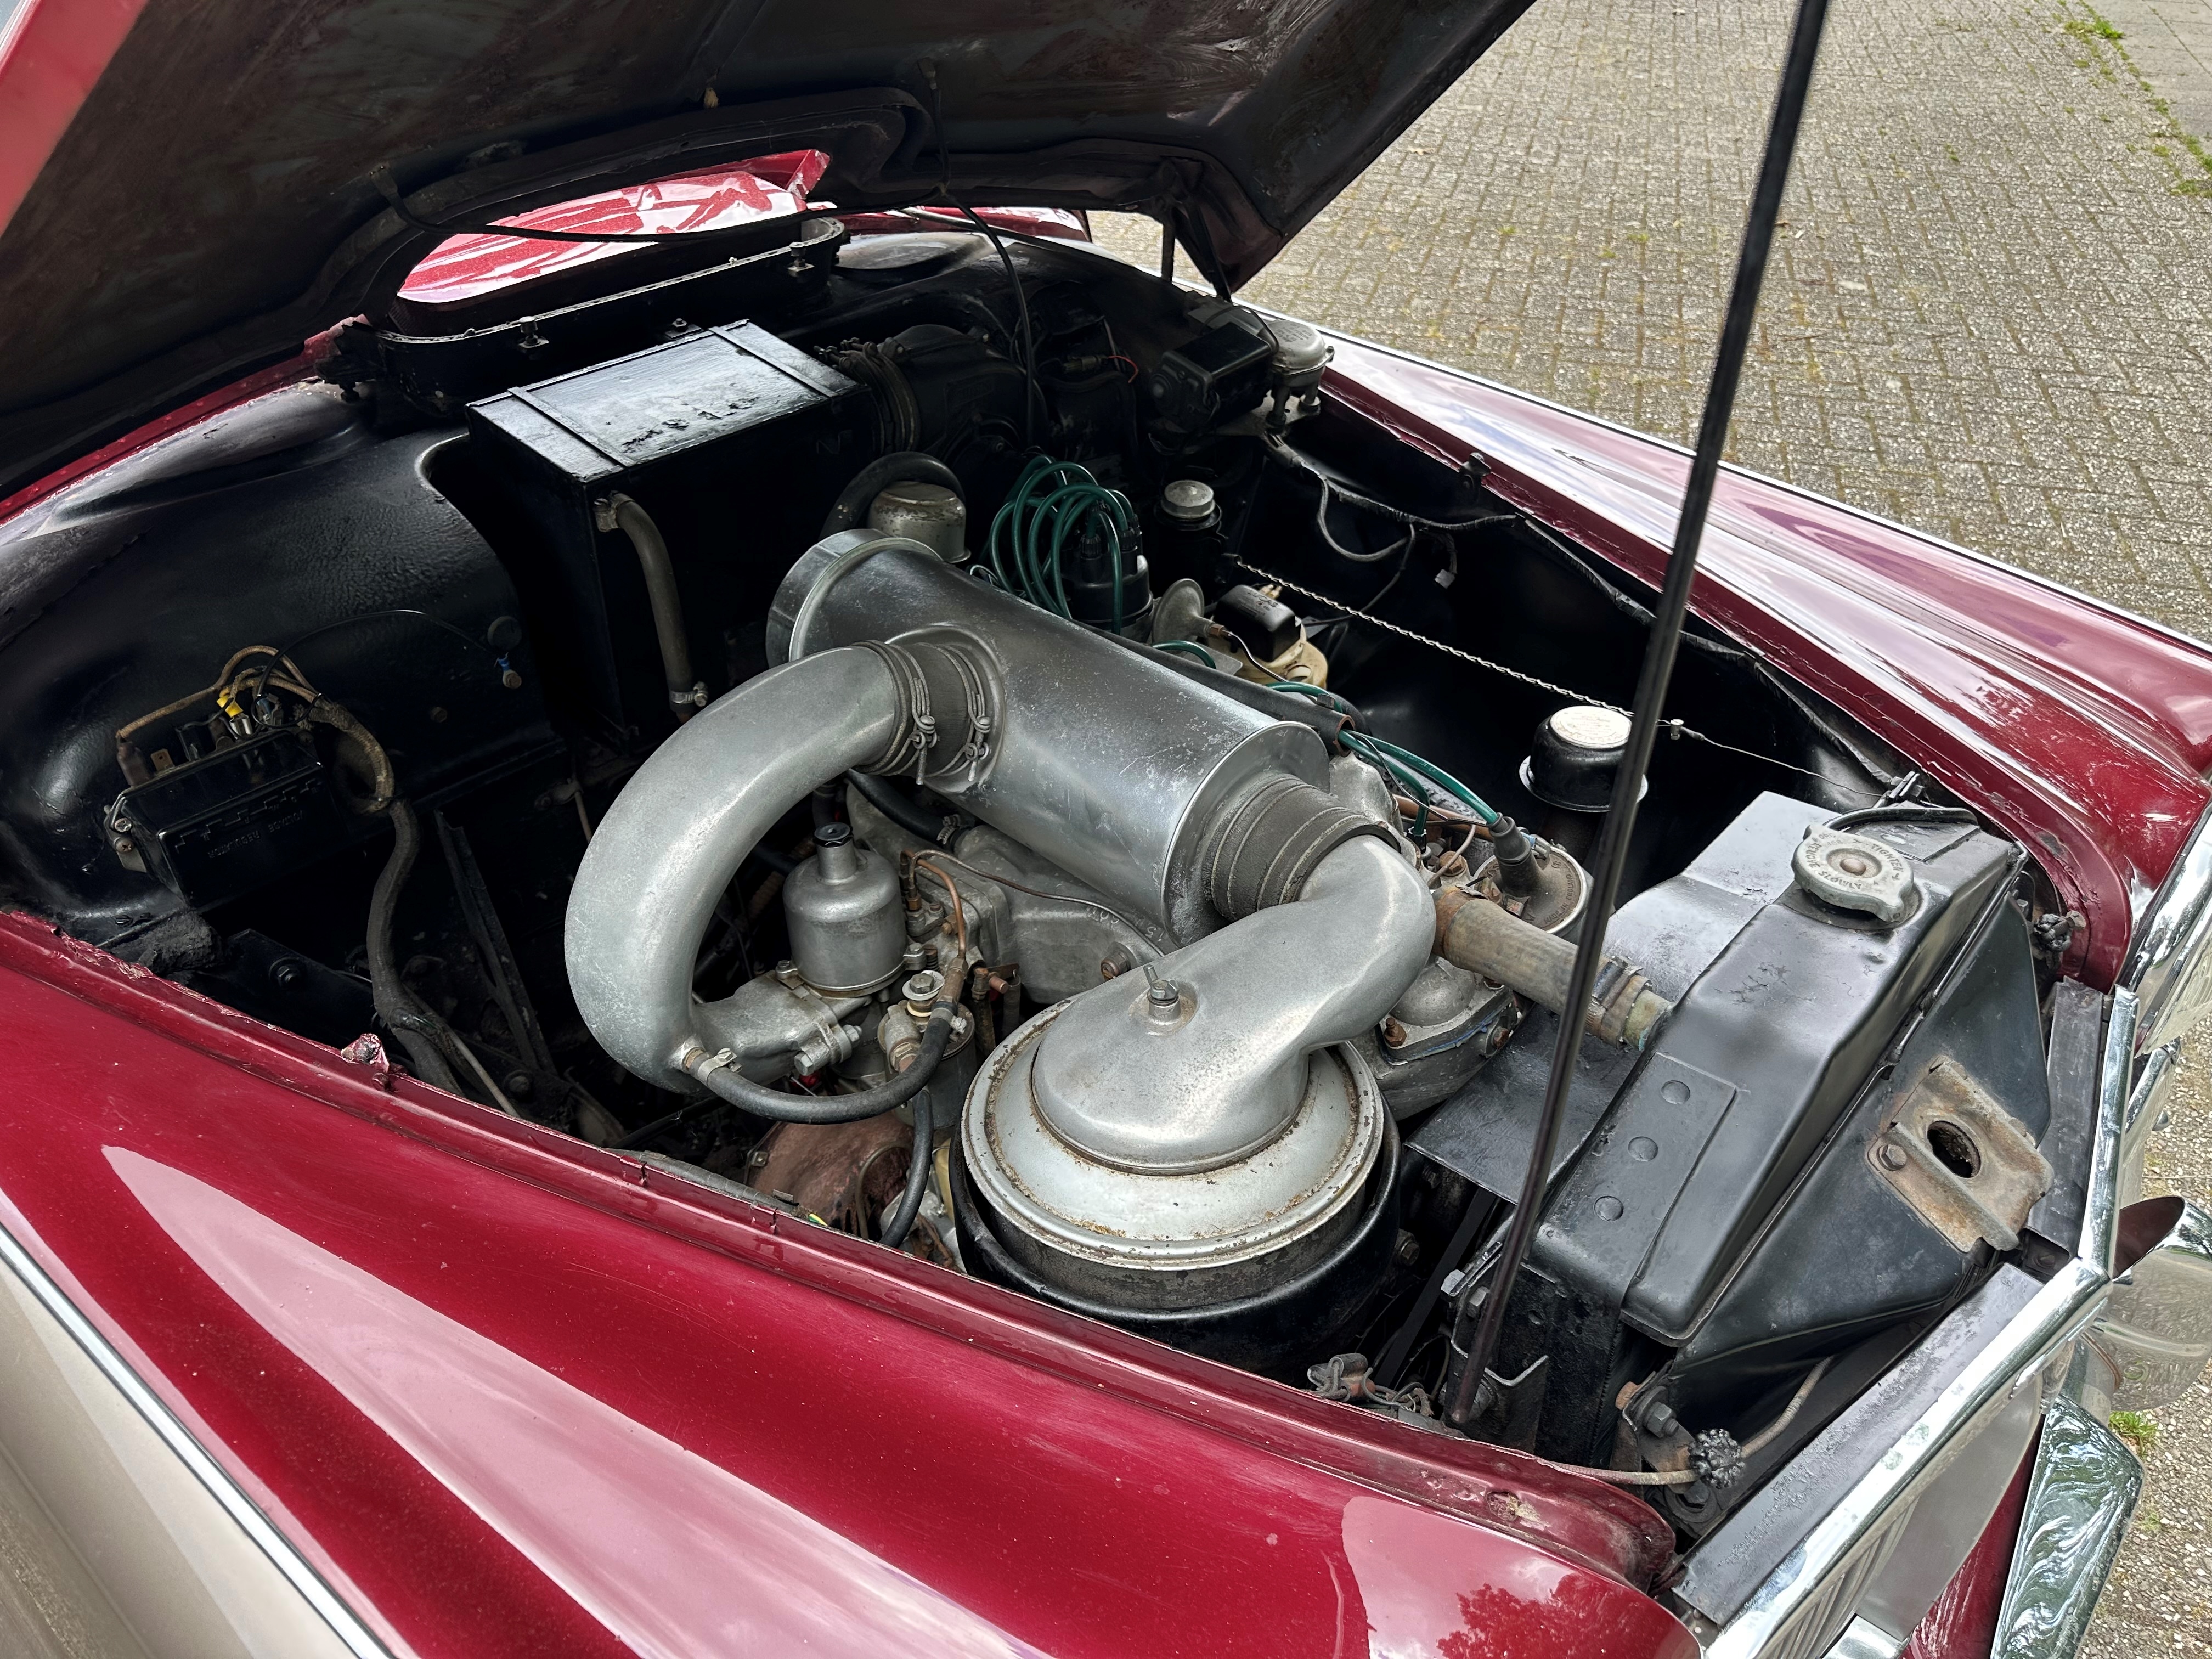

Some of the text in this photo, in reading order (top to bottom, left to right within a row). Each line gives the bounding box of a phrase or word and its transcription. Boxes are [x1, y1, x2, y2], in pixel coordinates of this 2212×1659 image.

[1805, 842, 1862, 890] REMOVE SLOWLY
[1870, 844, 1904, 872] TIGHTEN
[1544, 874, 1574, 924] MADE IN ENGLAND
